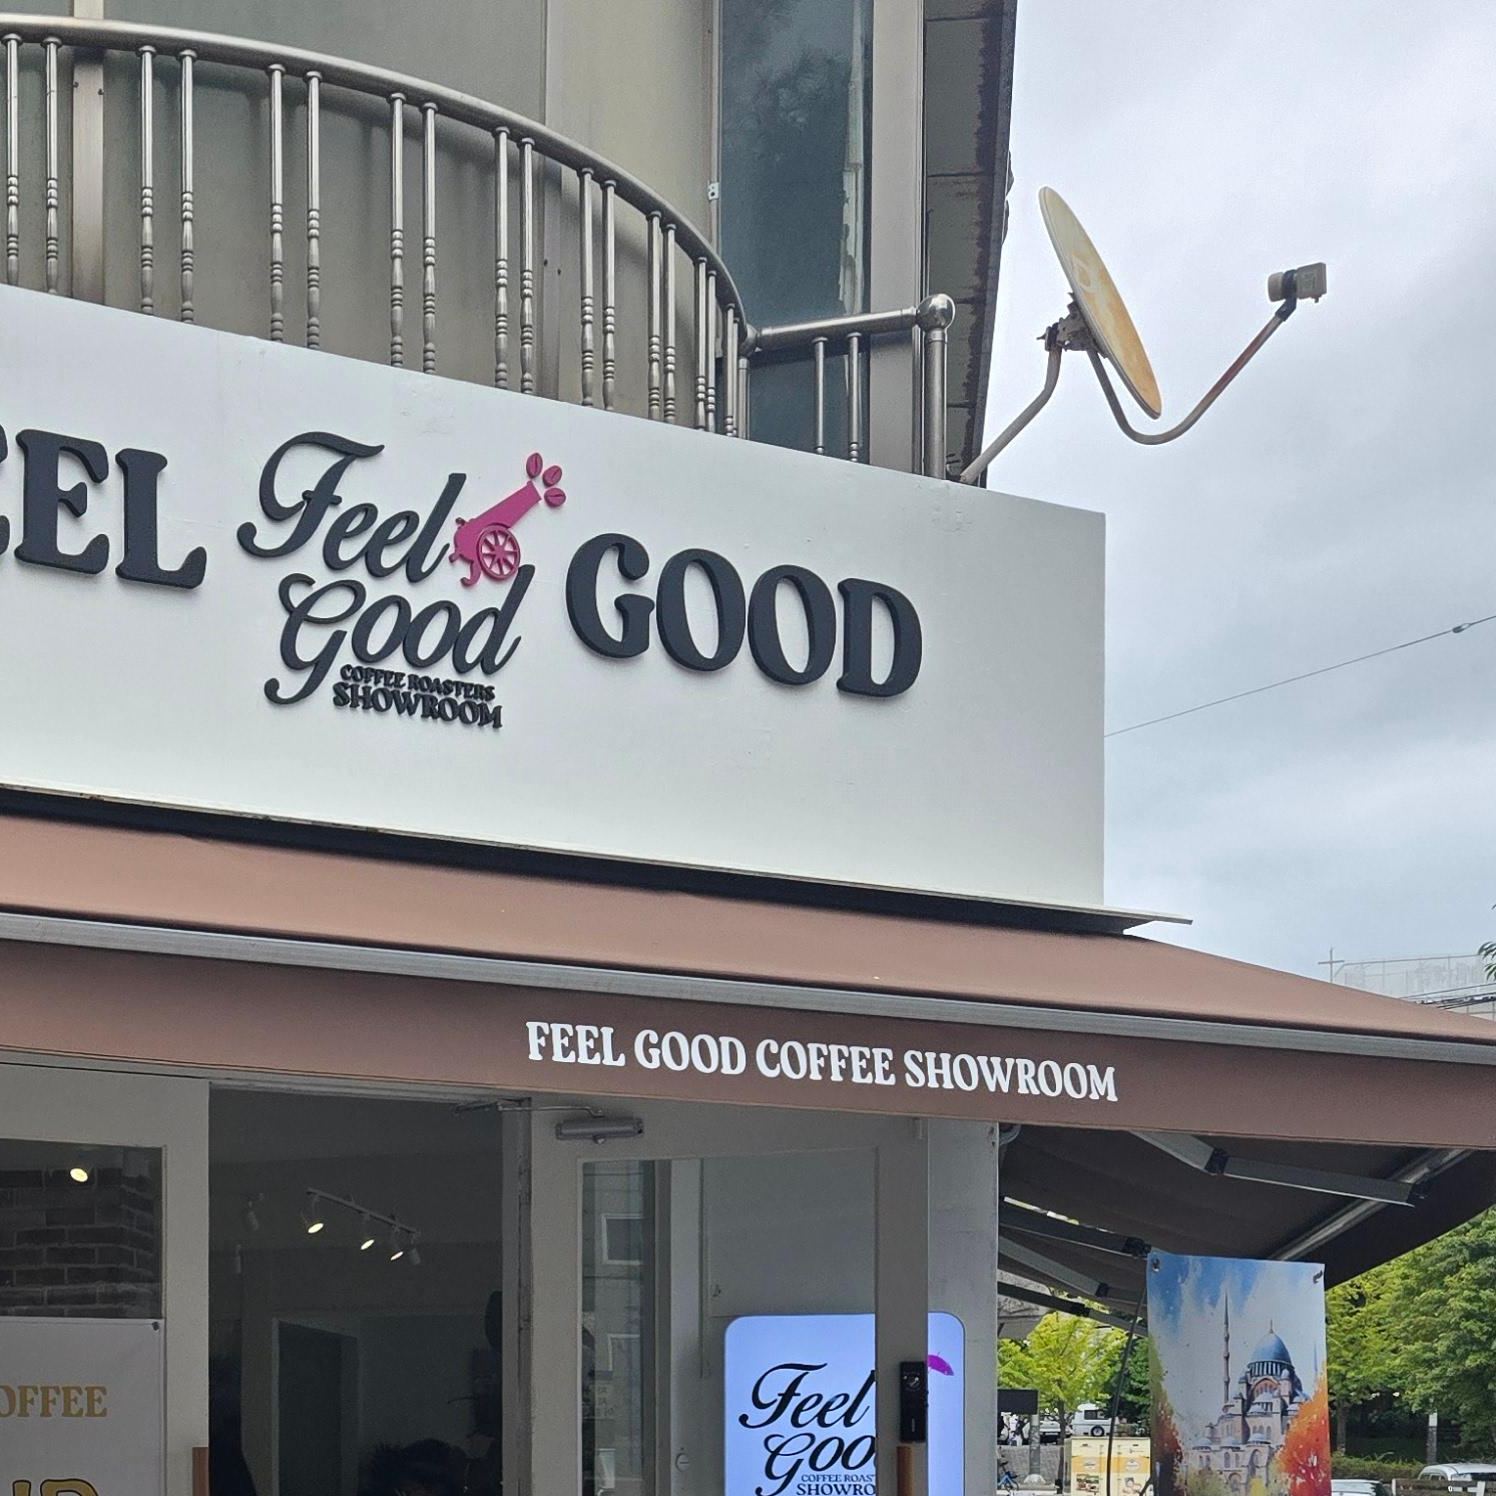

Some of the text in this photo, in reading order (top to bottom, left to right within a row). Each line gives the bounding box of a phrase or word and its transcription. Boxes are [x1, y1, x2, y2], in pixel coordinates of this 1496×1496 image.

[236, 431, 467, 583] Feel
[264, 563, 536, 705] Good
[566, 532, 923, 698] GOOD
[332, 681, 503, 729] SHOWROOM
[340, 664, 496, 702] COFFEE ROASTERS
[525, 1020, 1119, 1102] FEEL GOOD COFFEE SHOWROOM
[738, 1362, 876, 1429] Feel
[796, 1483, 876, 1496] SHOWRO
[801, 1474, 842, 1482] COFFEE
